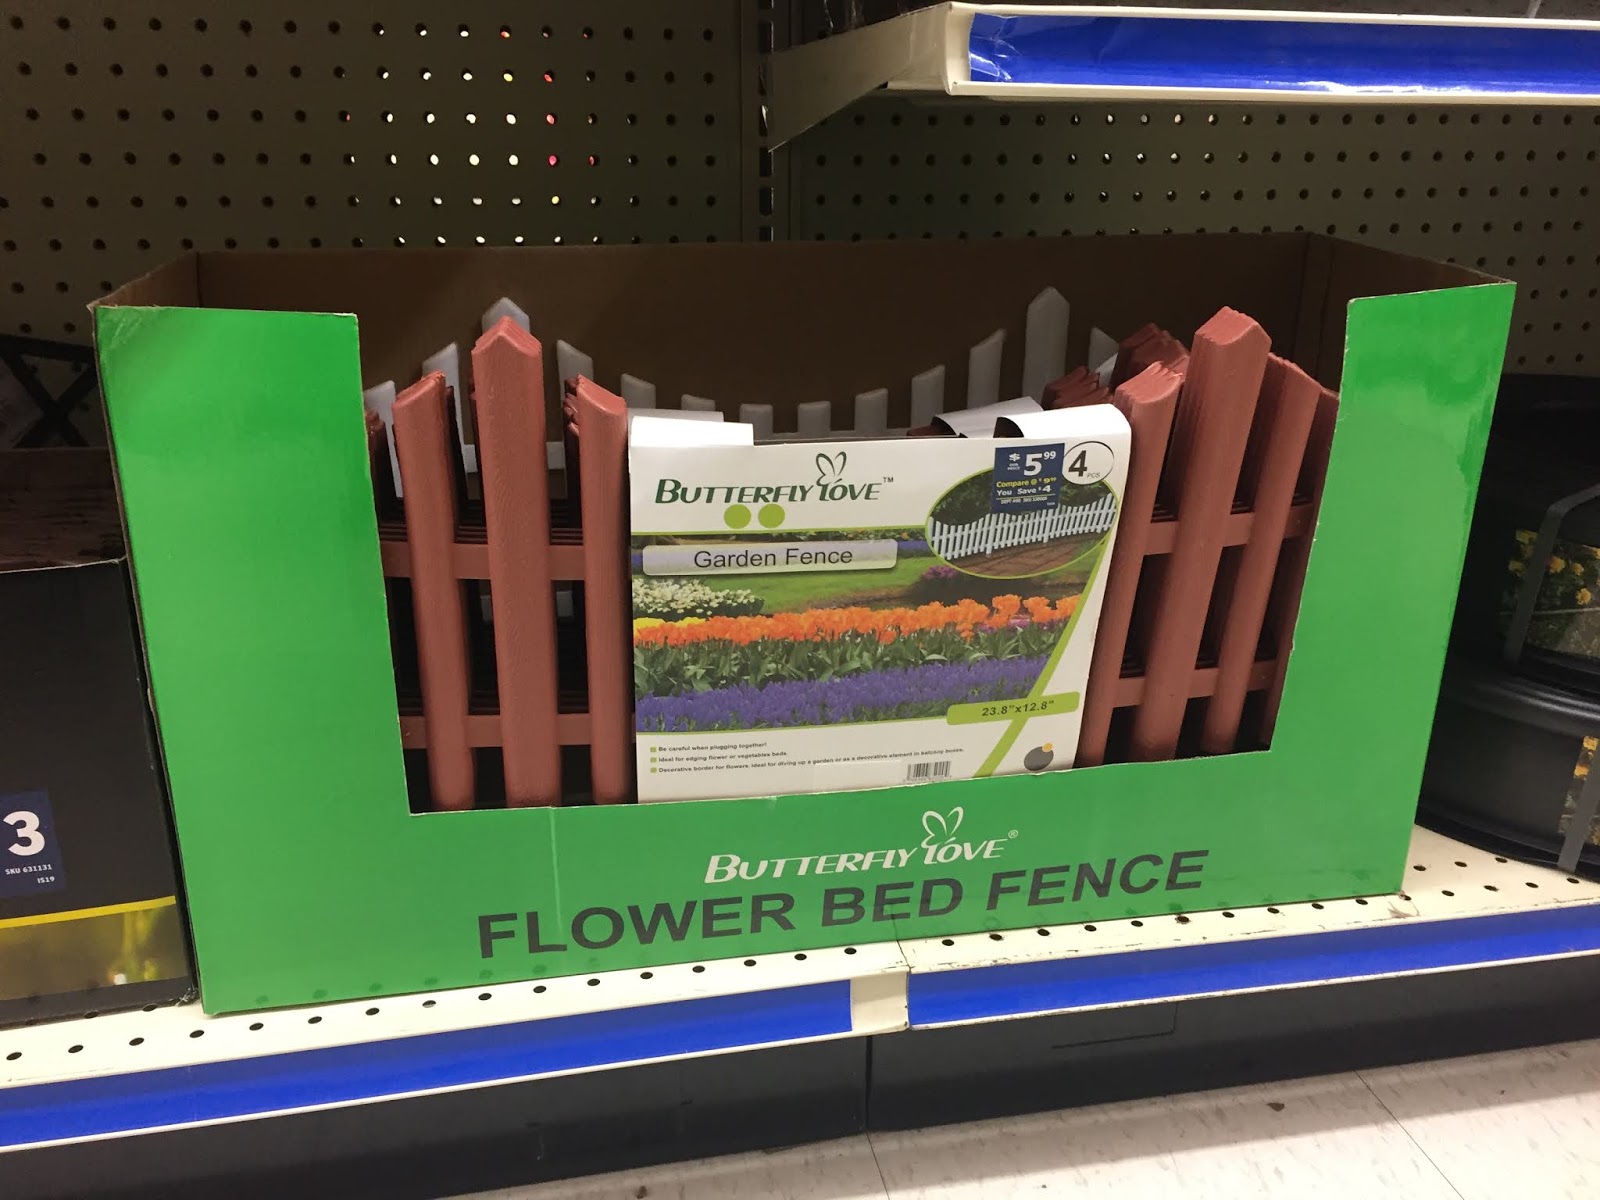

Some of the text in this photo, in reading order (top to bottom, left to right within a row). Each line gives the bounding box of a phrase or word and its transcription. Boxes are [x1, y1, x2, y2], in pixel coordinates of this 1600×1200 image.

[1068, 450, 1088, 477] 4
[655, 478, 814, 504] BUTTERFLY
[996, 480, 1030, 488] Compare
[1017, 487, 1037, 495] Save
[694, 548, 853, 569] Garden Fence
[3, 810, 46, 856] 3
[5, 863, 53, 875] SKU 631131
[703, 847, 918, 884] BUTTERFLY
[477, 849, 1210, 959] FLOWER BED FENCE
